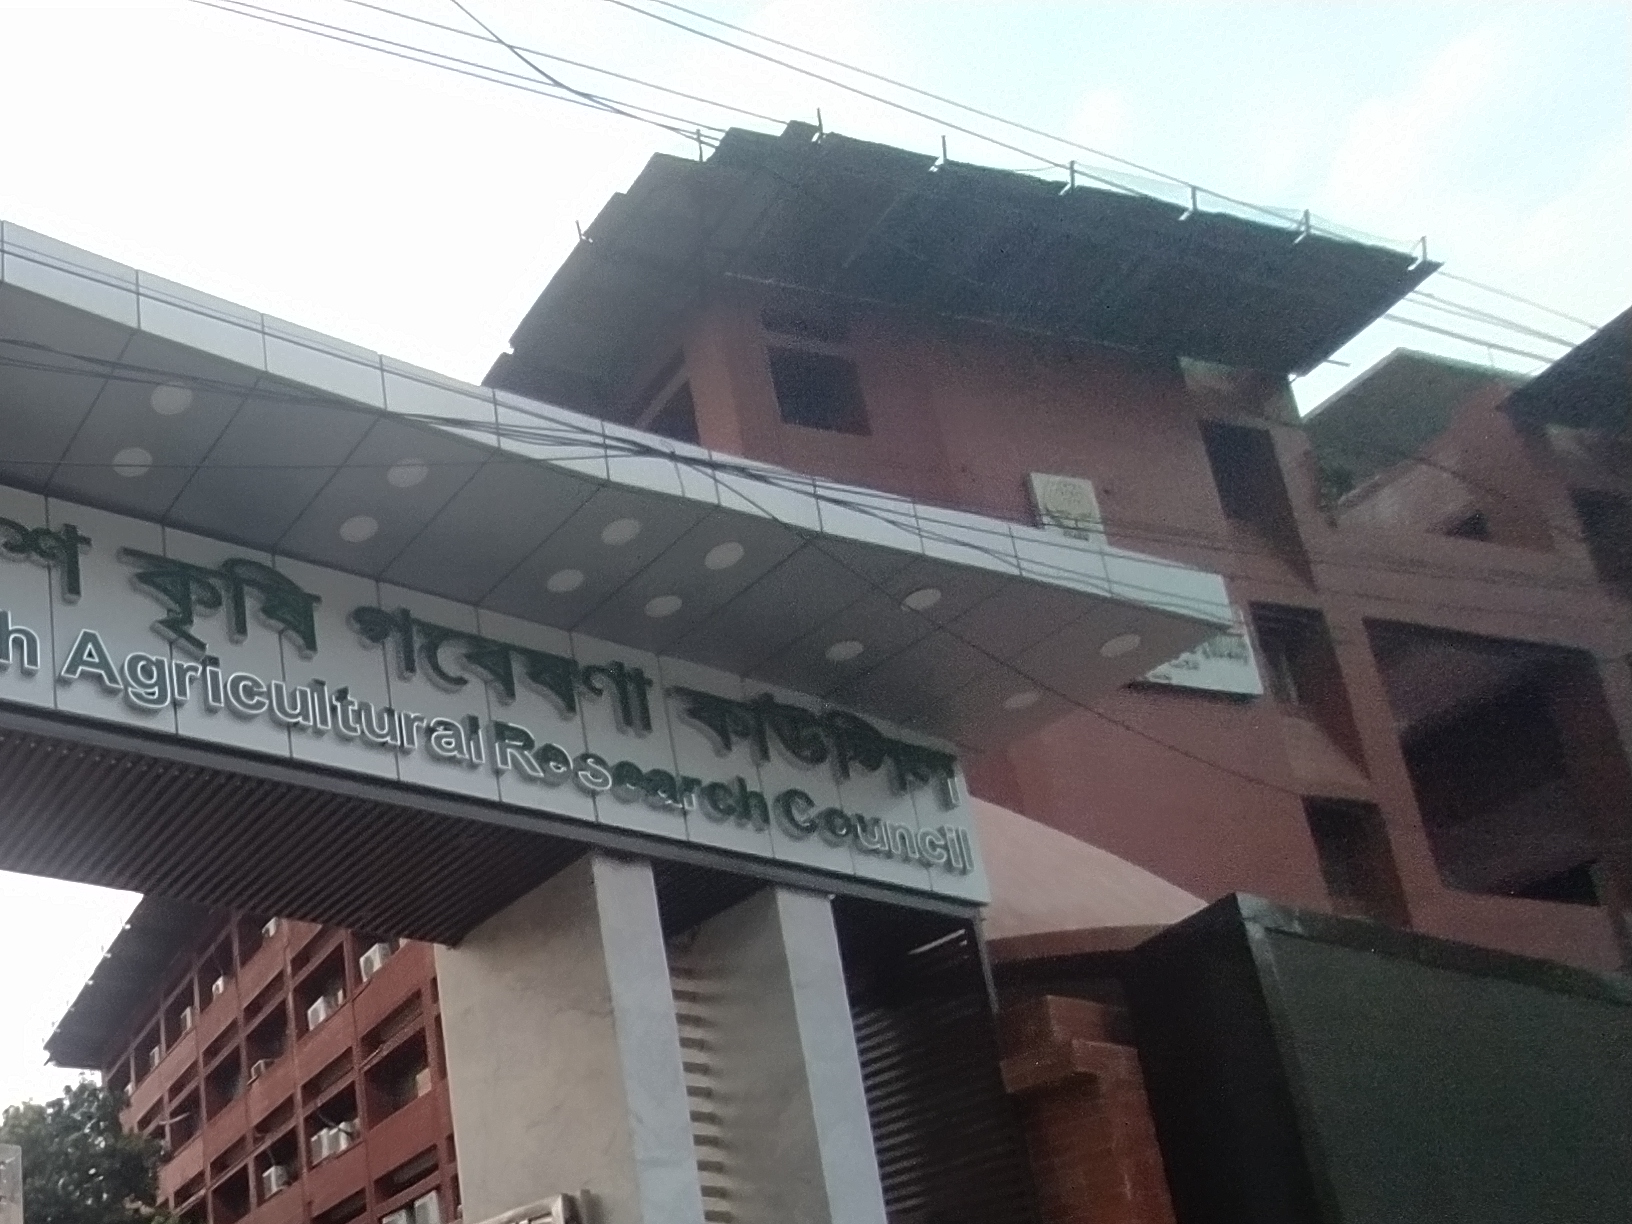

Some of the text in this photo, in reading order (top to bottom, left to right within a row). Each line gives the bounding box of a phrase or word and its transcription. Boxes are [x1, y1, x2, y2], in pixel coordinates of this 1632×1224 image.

[115, 546, 323, 660] কৃষি
[348, 604, 654, 737] গবেষণা
[58, 628, 487, 767] Agricultural
[488, 718, 771, 832] Research
[772, 788, 974, 876] Council
